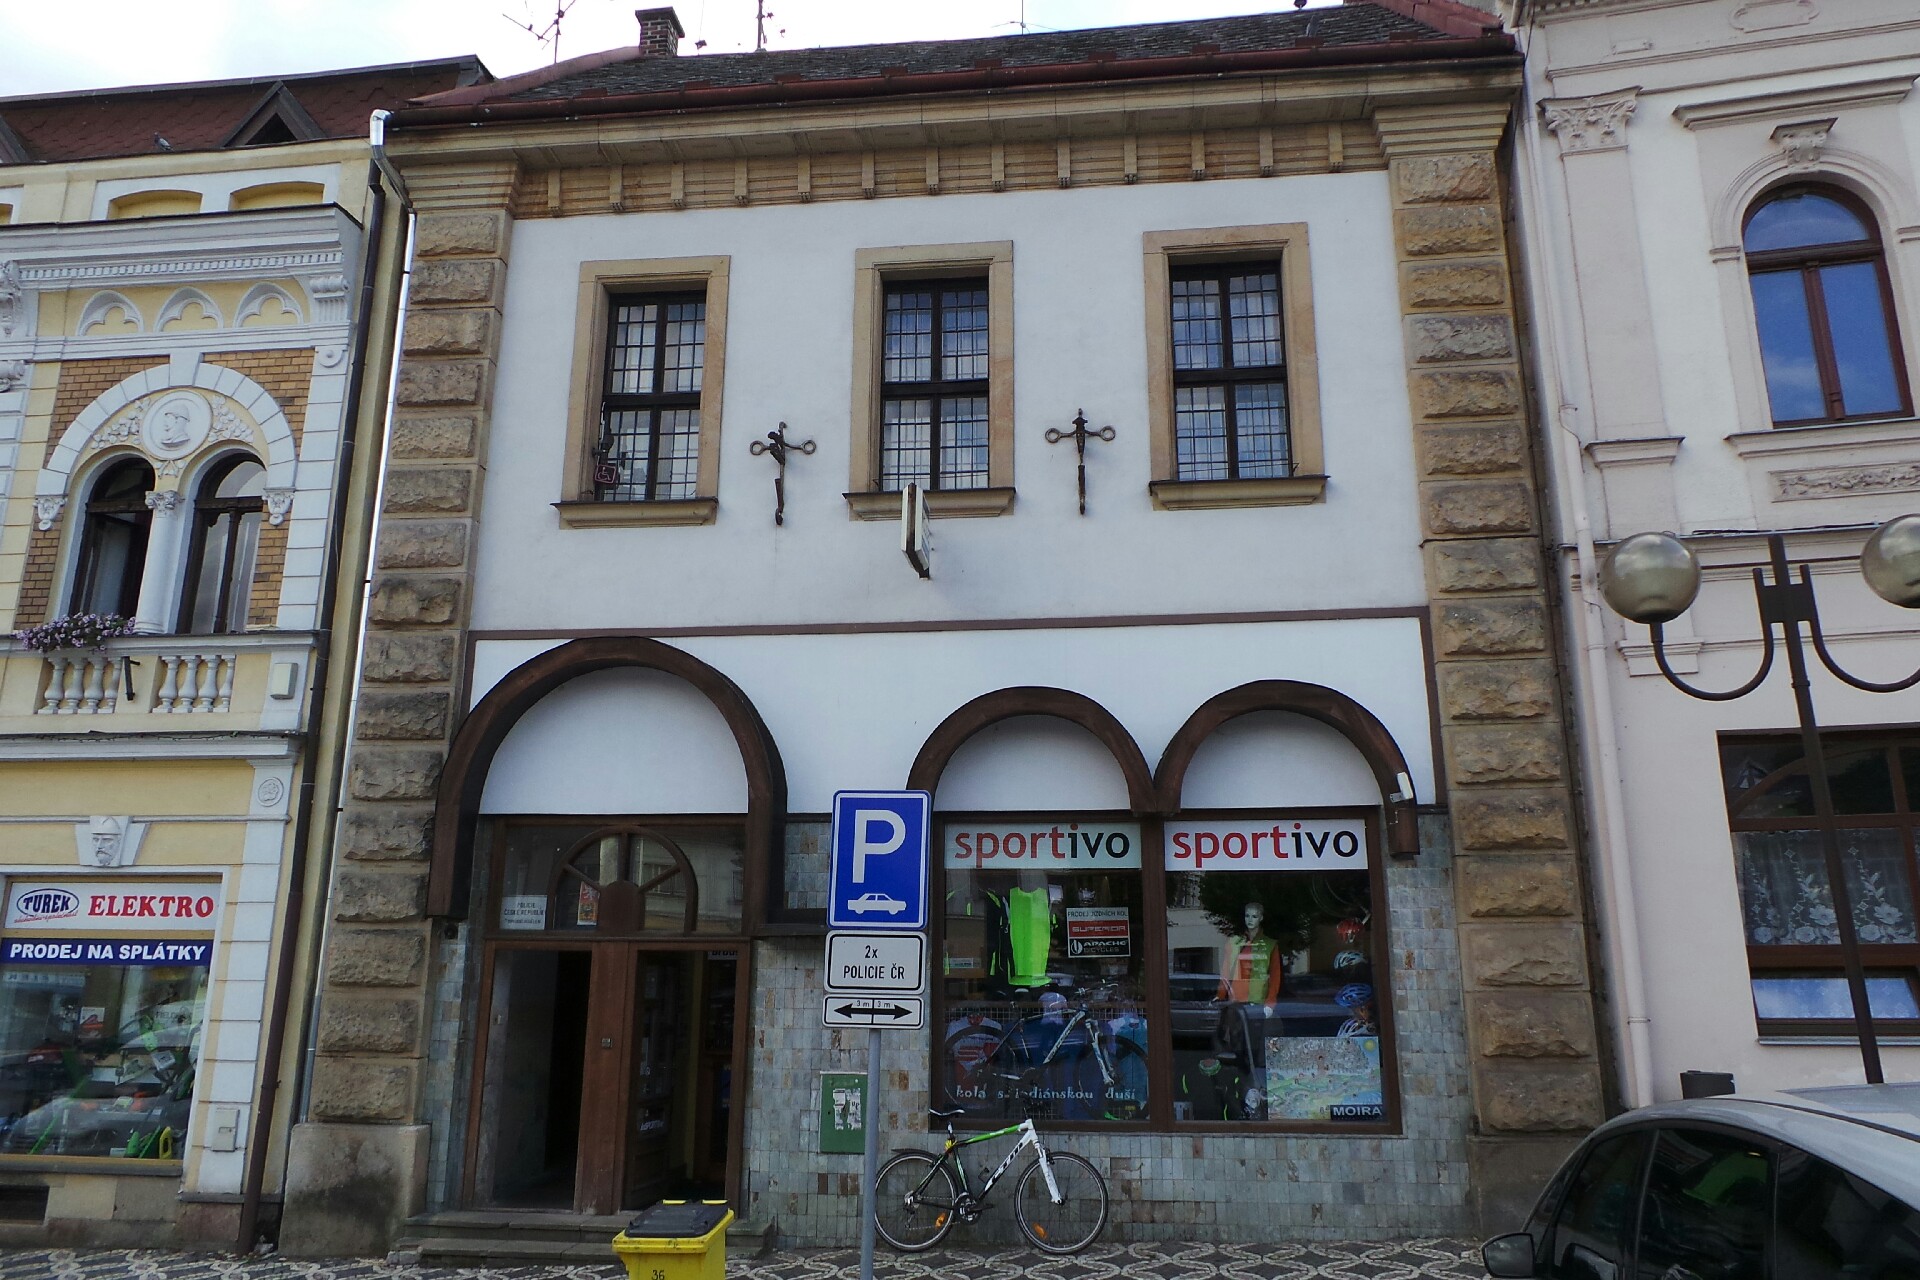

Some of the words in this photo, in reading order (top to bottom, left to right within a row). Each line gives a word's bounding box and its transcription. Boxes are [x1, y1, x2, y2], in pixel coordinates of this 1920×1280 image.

[852, 809, 906, 883] P
[954, 823, 1130, 868] sportivo
[1172, 822, 1359, 868] sportivo
[23, 894, 71, 914] TUREK
[88, 895, 214, 918] ELEKTRO
[10, 943, 82, 959] PRODEJ
[87, 945, 114, 960] NA
[119, 942, 206, 961] SPLÁTKY
[864, 945, 878, 959] 2x
[843, 965, 885, 979] POLICIE
[890, 963, 905, 980] ČR
[1105, 1086, 1136, 1099] duší
[1333, 1106, 1382, 1116] MOIRA
[651, 1269, 665, 1280] 36
